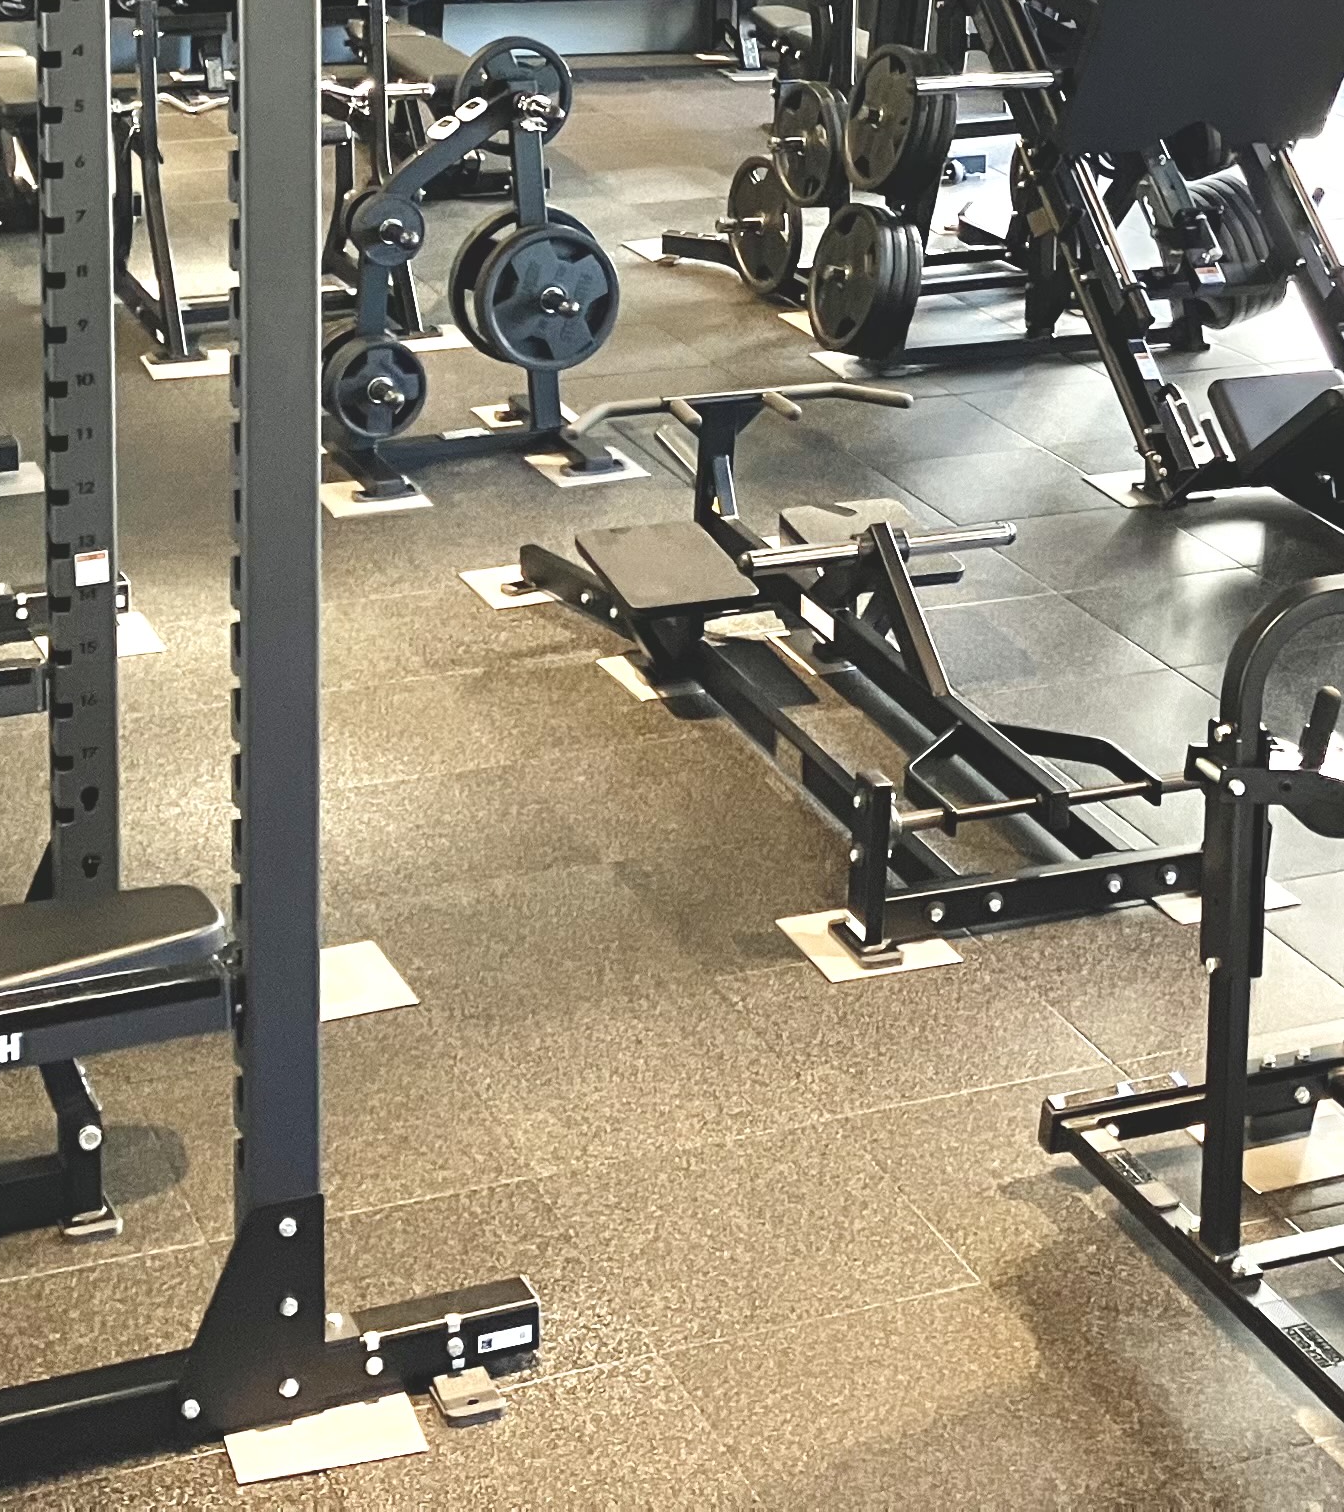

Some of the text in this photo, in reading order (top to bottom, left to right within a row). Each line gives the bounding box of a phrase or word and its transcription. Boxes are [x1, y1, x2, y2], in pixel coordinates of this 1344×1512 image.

[72, 44, 84, 57] 4
[74, 99, 84, 113] 5
[74, 155, 85, 168] 6
[75, 209, 87, 222] 7
[77, 319, 88, 332] 9
[76, 373, 94, 387] 10
[76, 427, 93, 441] 11
[76, 482, 95, 495] 12
